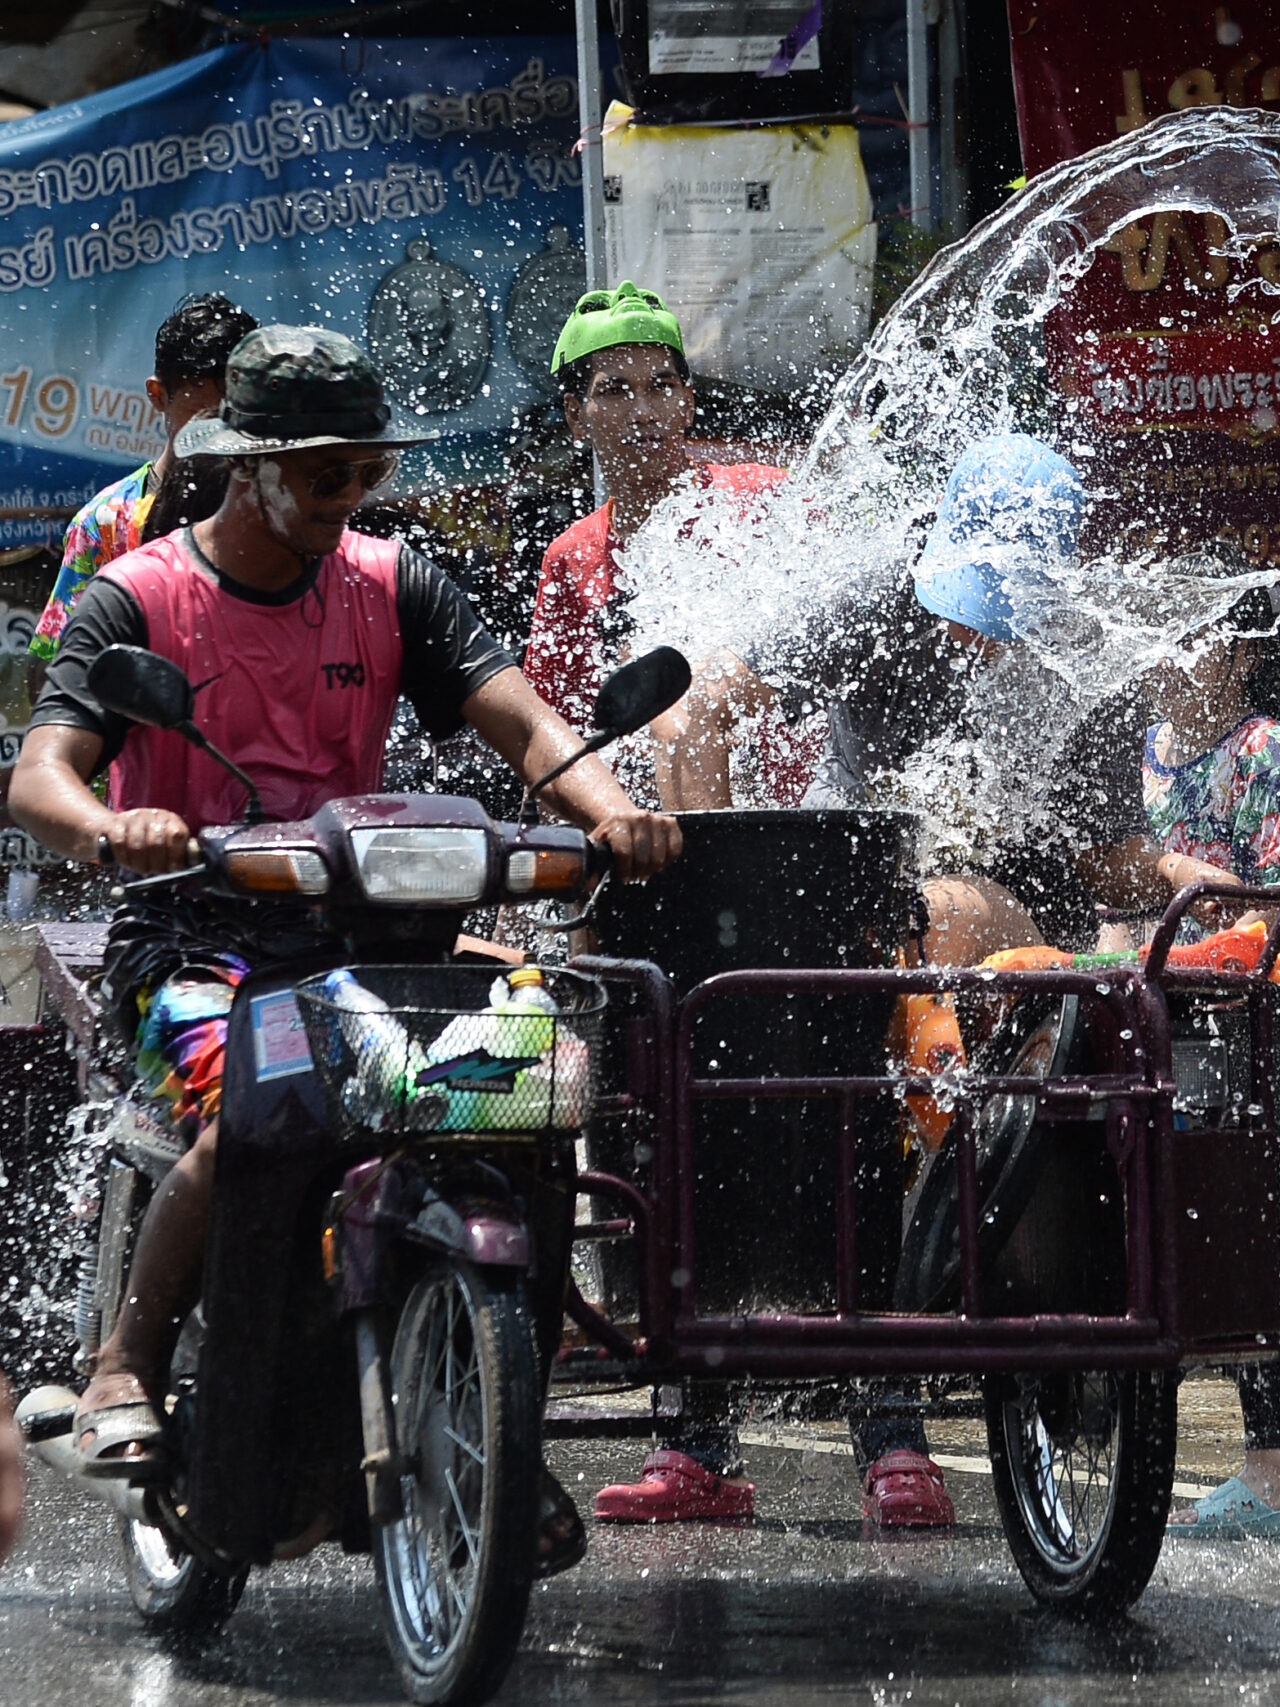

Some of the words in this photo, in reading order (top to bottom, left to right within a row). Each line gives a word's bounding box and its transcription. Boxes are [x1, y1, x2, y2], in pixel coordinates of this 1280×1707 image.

[0, 57, 579, 215] ระกวดและอนุรักษ์พระเครื่อ
[452, 151, 522, 207] 14
[2, 366, 79, 438] 19
[450, 1079, 510, 1090] HONDA
